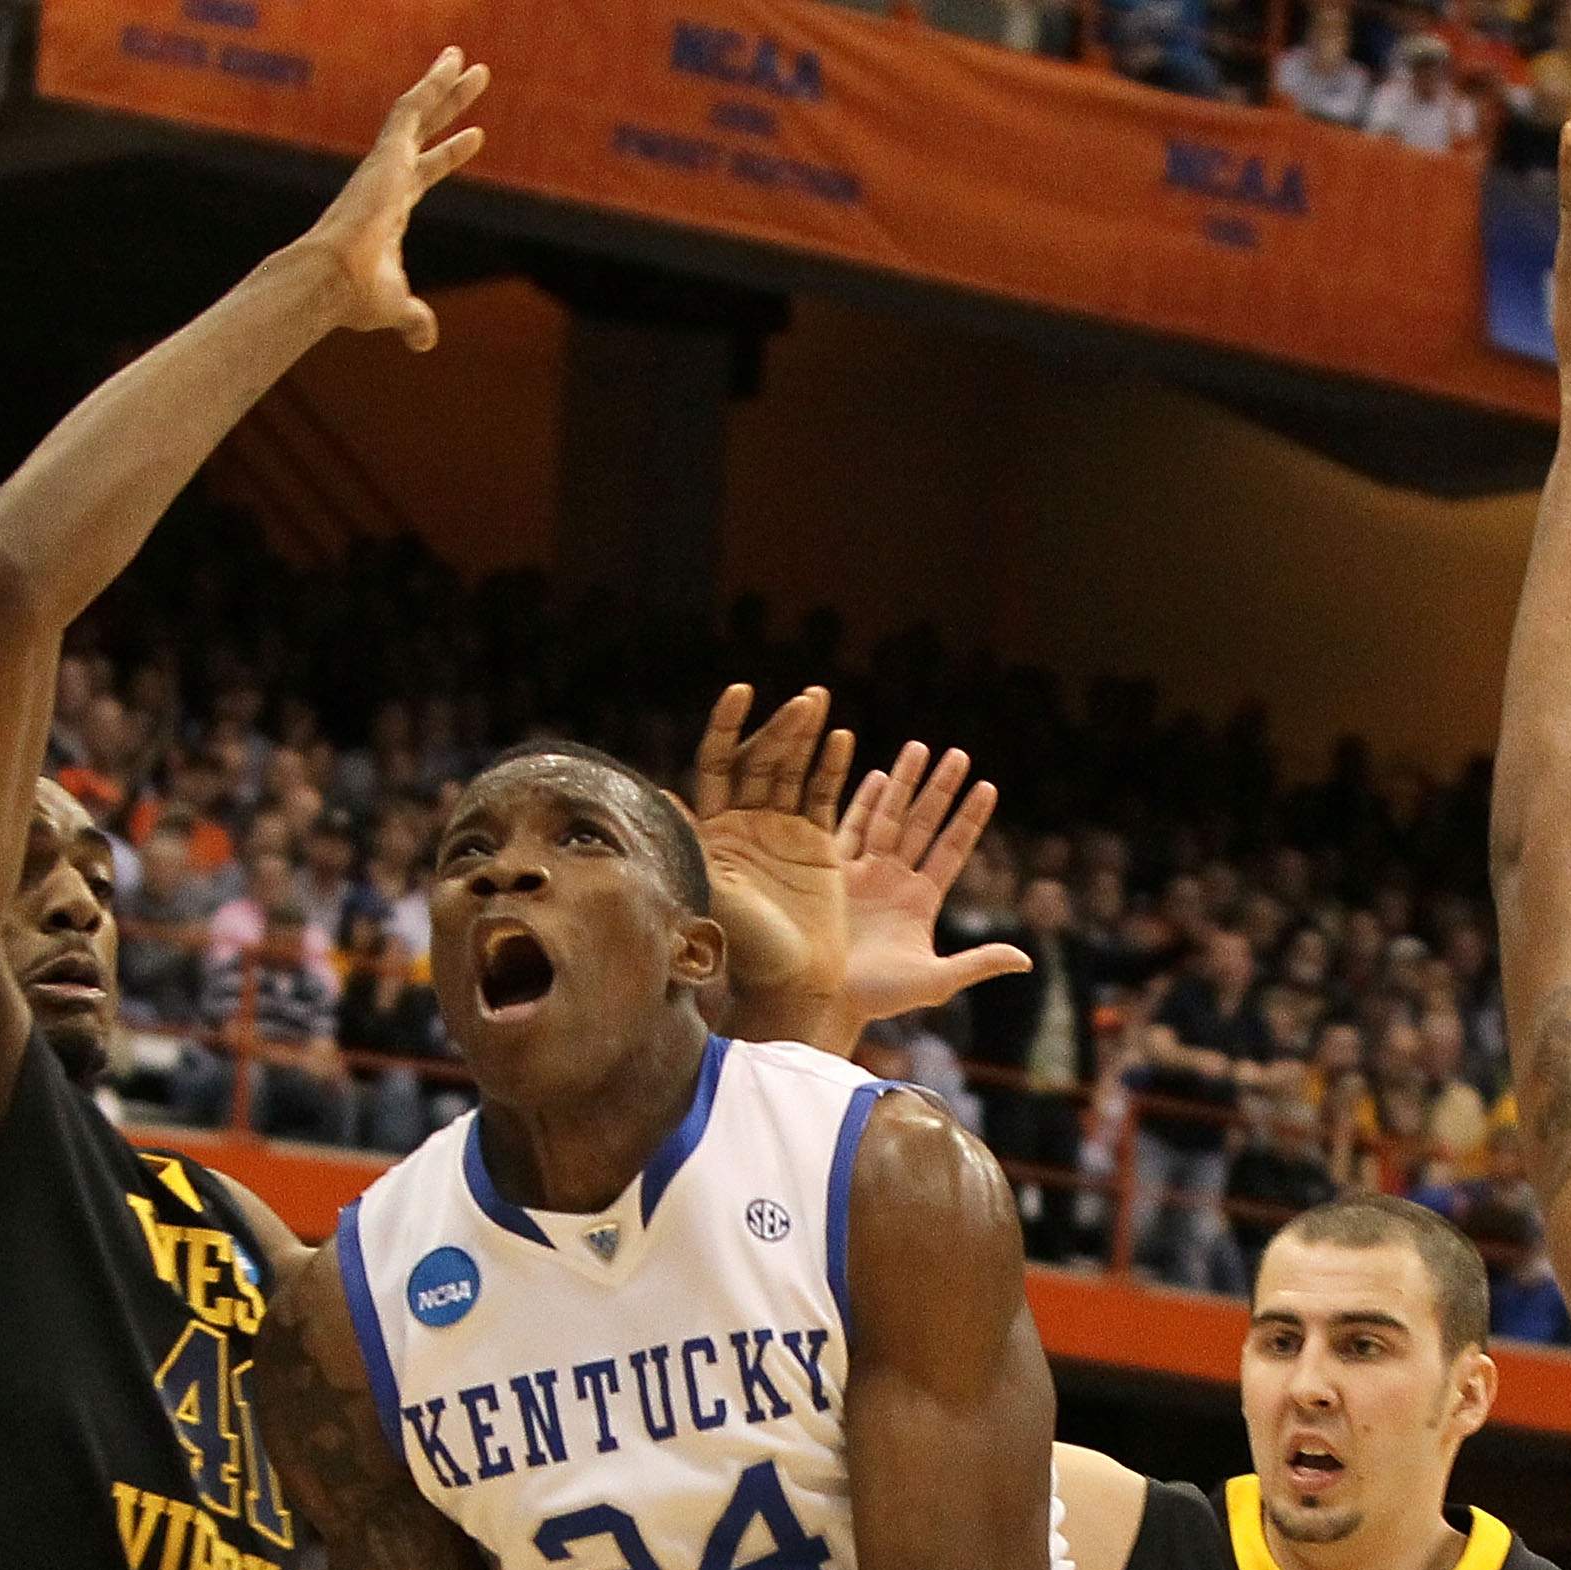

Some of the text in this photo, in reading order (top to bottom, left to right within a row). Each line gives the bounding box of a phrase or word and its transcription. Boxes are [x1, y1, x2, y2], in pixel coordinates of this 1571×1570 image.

[126, 1192, 267, 1335] WES
[747, 1199, 791, 1240] SEC
[417, 1279, 473, 1312] NCAA
[401, 1328, 834, 1489] KENTUCKY
